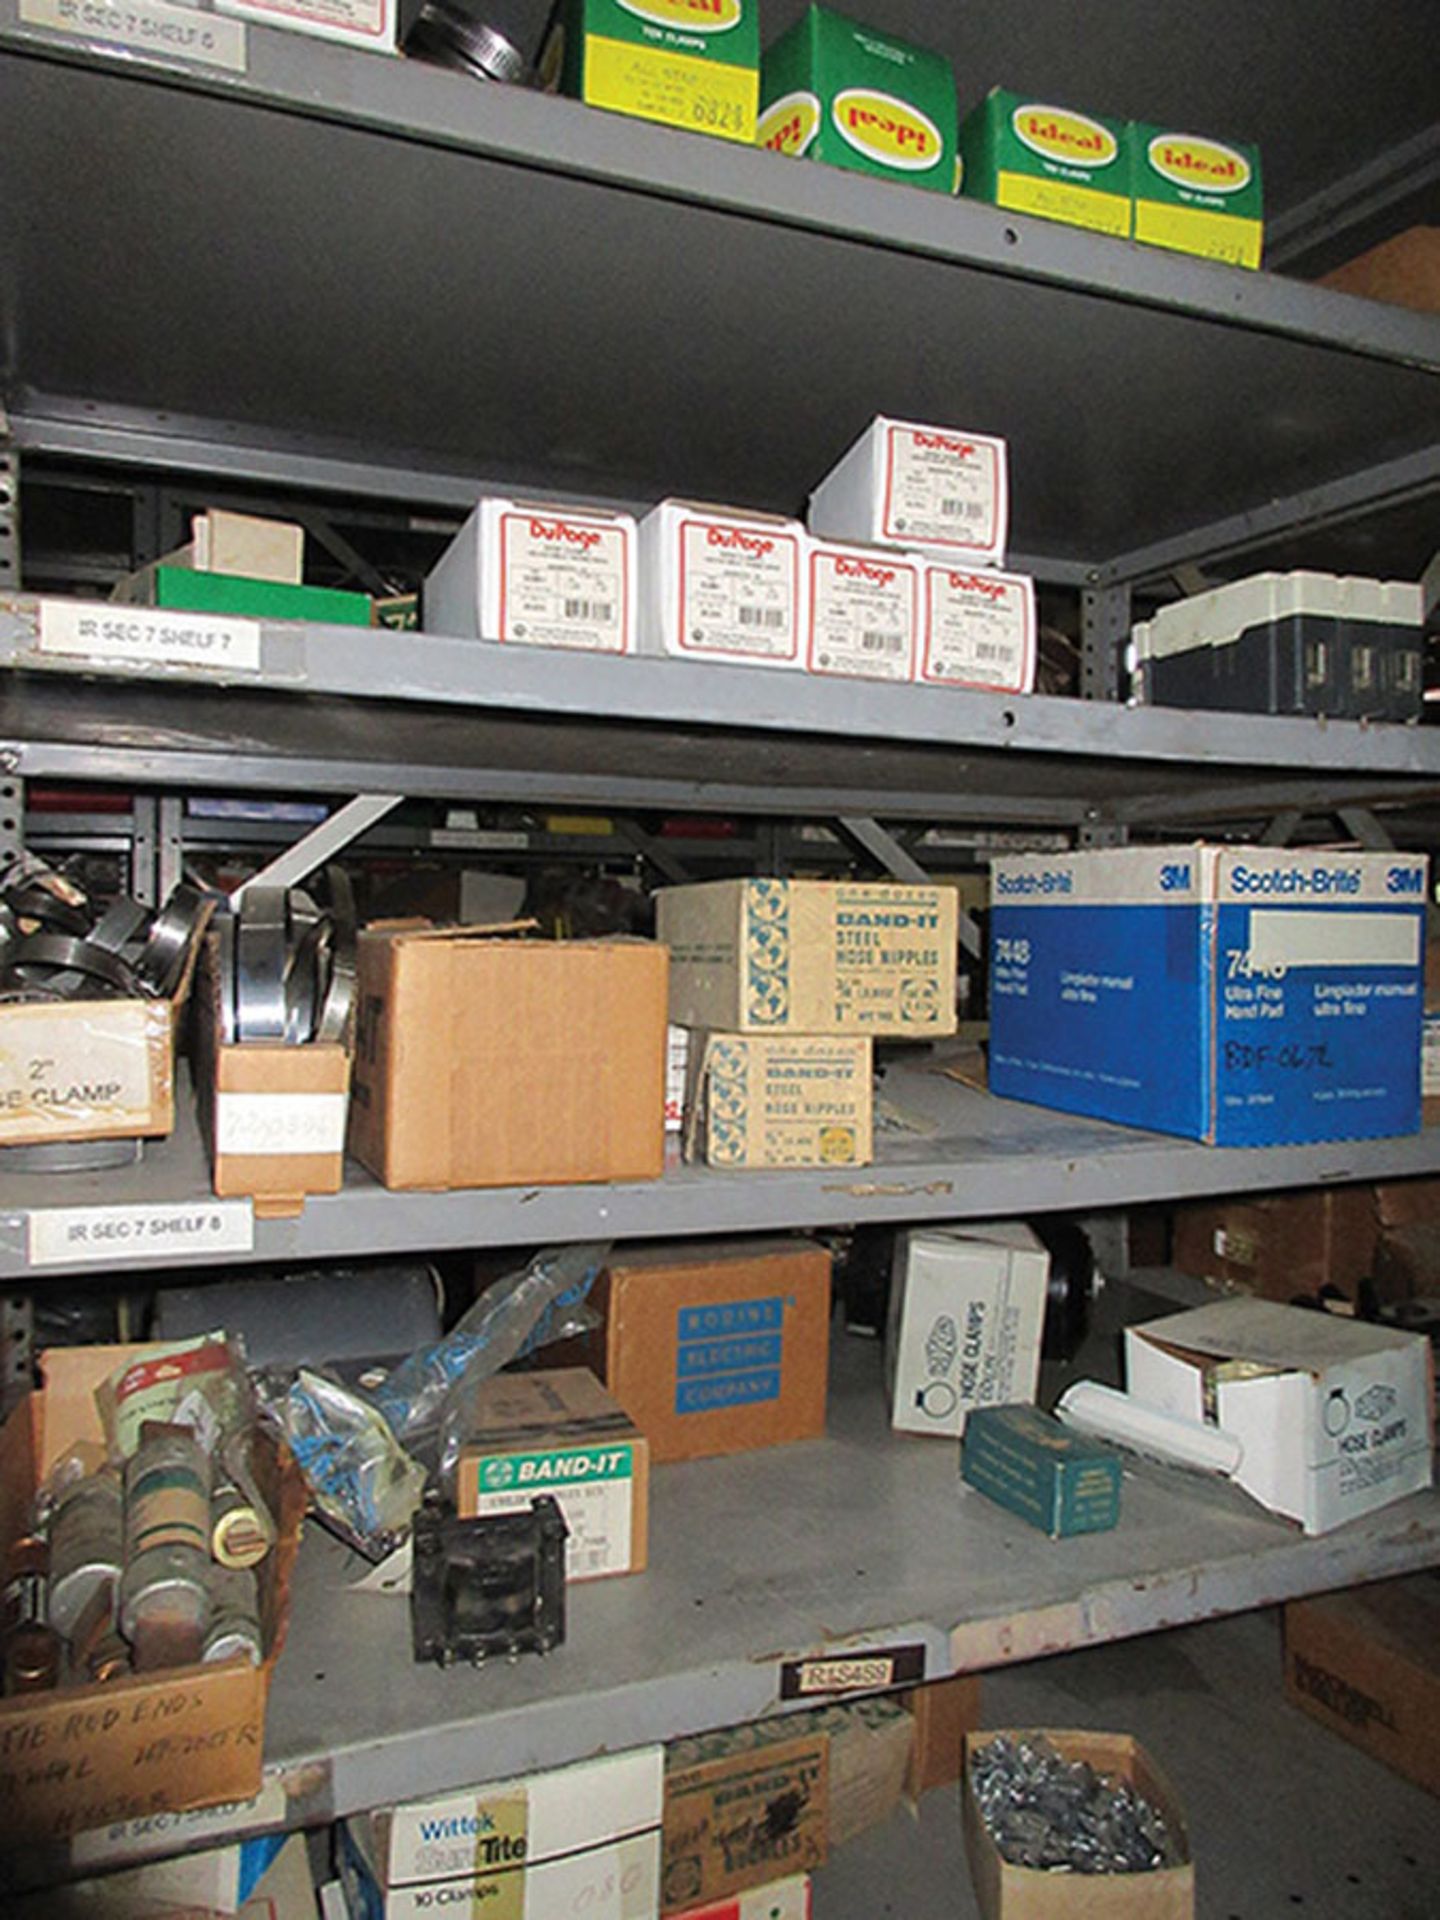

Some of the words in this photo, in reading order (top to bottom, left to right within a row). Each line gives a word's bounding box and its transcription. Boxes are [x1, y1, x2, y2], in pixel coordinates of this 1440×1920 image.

[83, 4, 121, 30] SEC
[1029, 117, 1103, 152] ideal
[1163, 148, 1236, 177] ideal
[102, 620, 140, 641] SEC
[145, 625, 156, 642] 7
[159, 626, 215, 648] SHELF
[221, 633, 232, 649] 7
[997, 871, 1073, 894] Scotch-Brite
[1160, 865, 1191, 891] 3M
[1231, 865, 1361, 894] Scotch-Brite
[1386, 866, 1423, 894] 3M
[836, 913, 938, 928] BAND-IT
[836, 930, 880, 946] STEEL
[836, 950, 873, 964] HOSE
[880, 949, 938, 965] NIPPLES
[766, 1067, 855, 1079] BAND-IT
[31, 1083, 121, 1107] CLAMP
[67, 1223, 89, 1242] IR
[92, 1220, 131, 1240] SEC
[134, 1220, 146, 1236] 7
[149, 1215, 206, 1236] SHELF
[958, 1361, 979, 1400] HOSE
[517, 1452, 627, 1482] BAND-IT
[435, 1883, 499, 1906] Clamps
